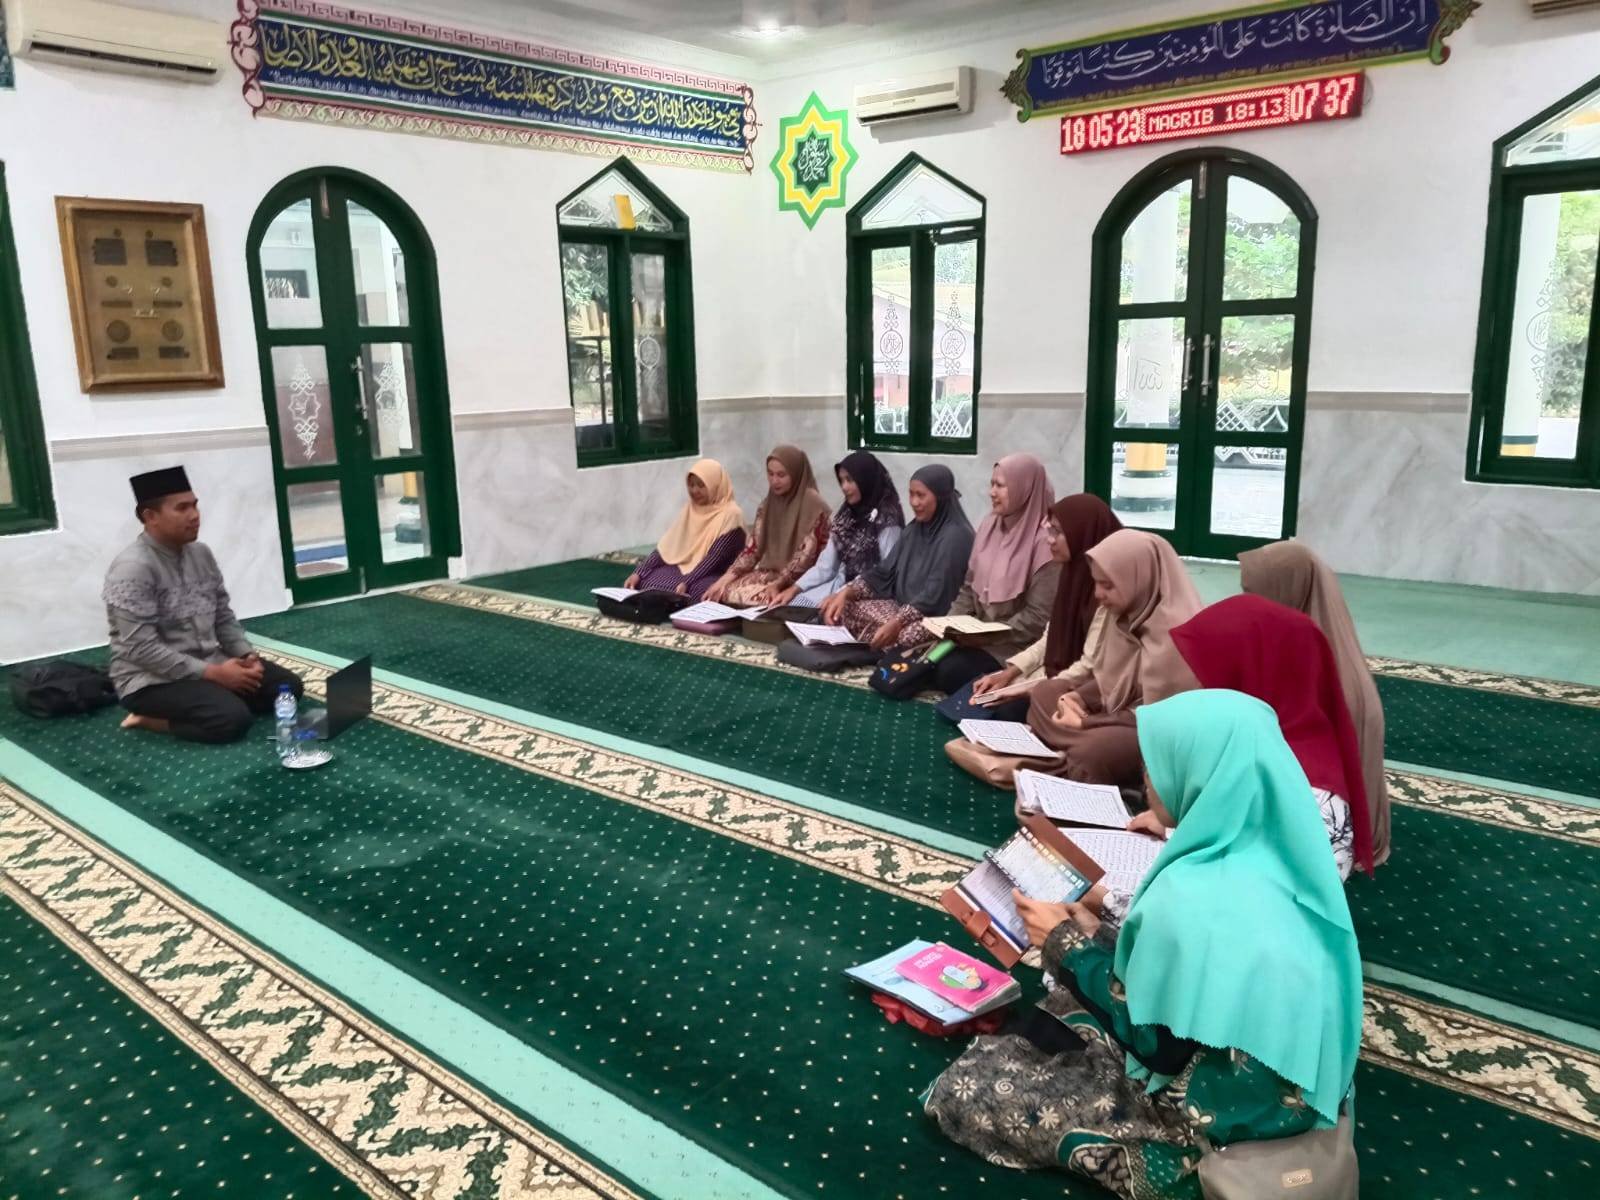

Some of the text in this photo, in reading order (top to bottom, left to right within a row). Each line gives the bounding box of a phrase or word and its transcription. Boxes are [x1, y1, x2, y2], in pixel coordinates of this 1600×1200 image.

[1062, 76, 1356, 152] 18 05 23 MAGRIB 18:13 07 37
